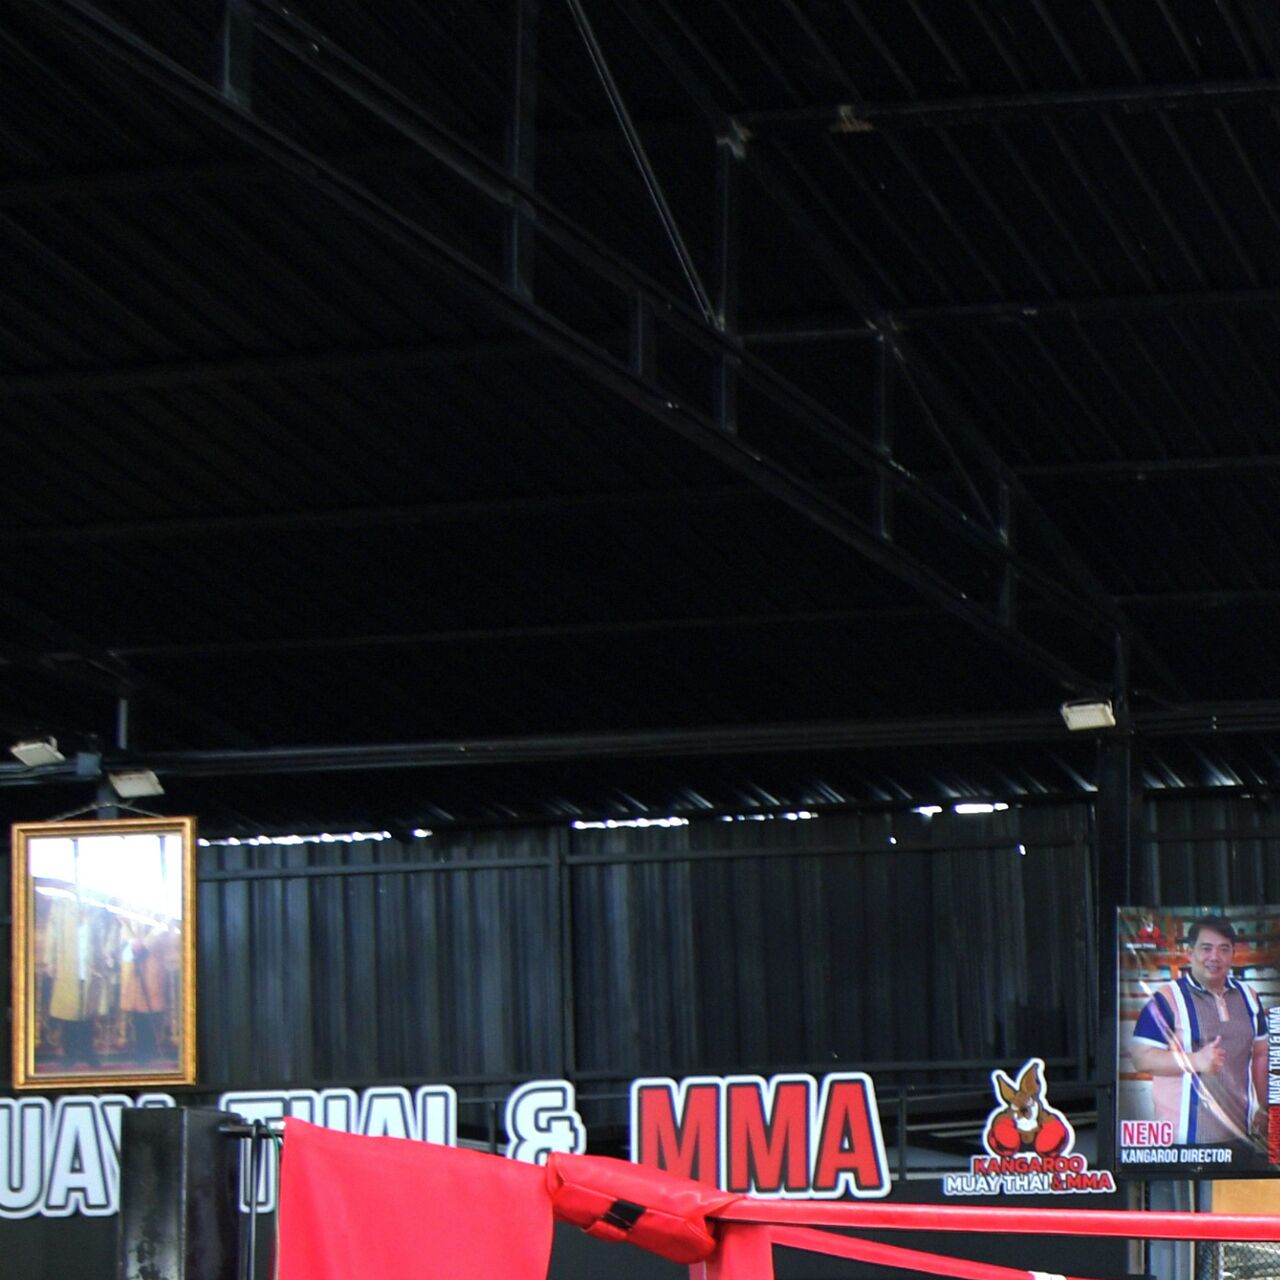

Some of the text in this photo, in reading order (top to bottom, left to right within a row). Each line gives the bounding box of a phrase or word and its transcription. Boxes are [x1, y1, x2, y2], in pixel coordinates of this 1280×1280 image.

[630, 1072, 890, 1198] MMA
[1121, 1120, 1173, 1147] NENG
[972, 1155, 1085, 1175] KANGAROO
[1121, 1149, 1232, 1164] KANGAROO DIRECTOR
[945, 1174, 1000, 1193] MUAY
[1003, 1173, 1050, 1192] THAI
[1066, 1172, 1114, 1191] MMA
